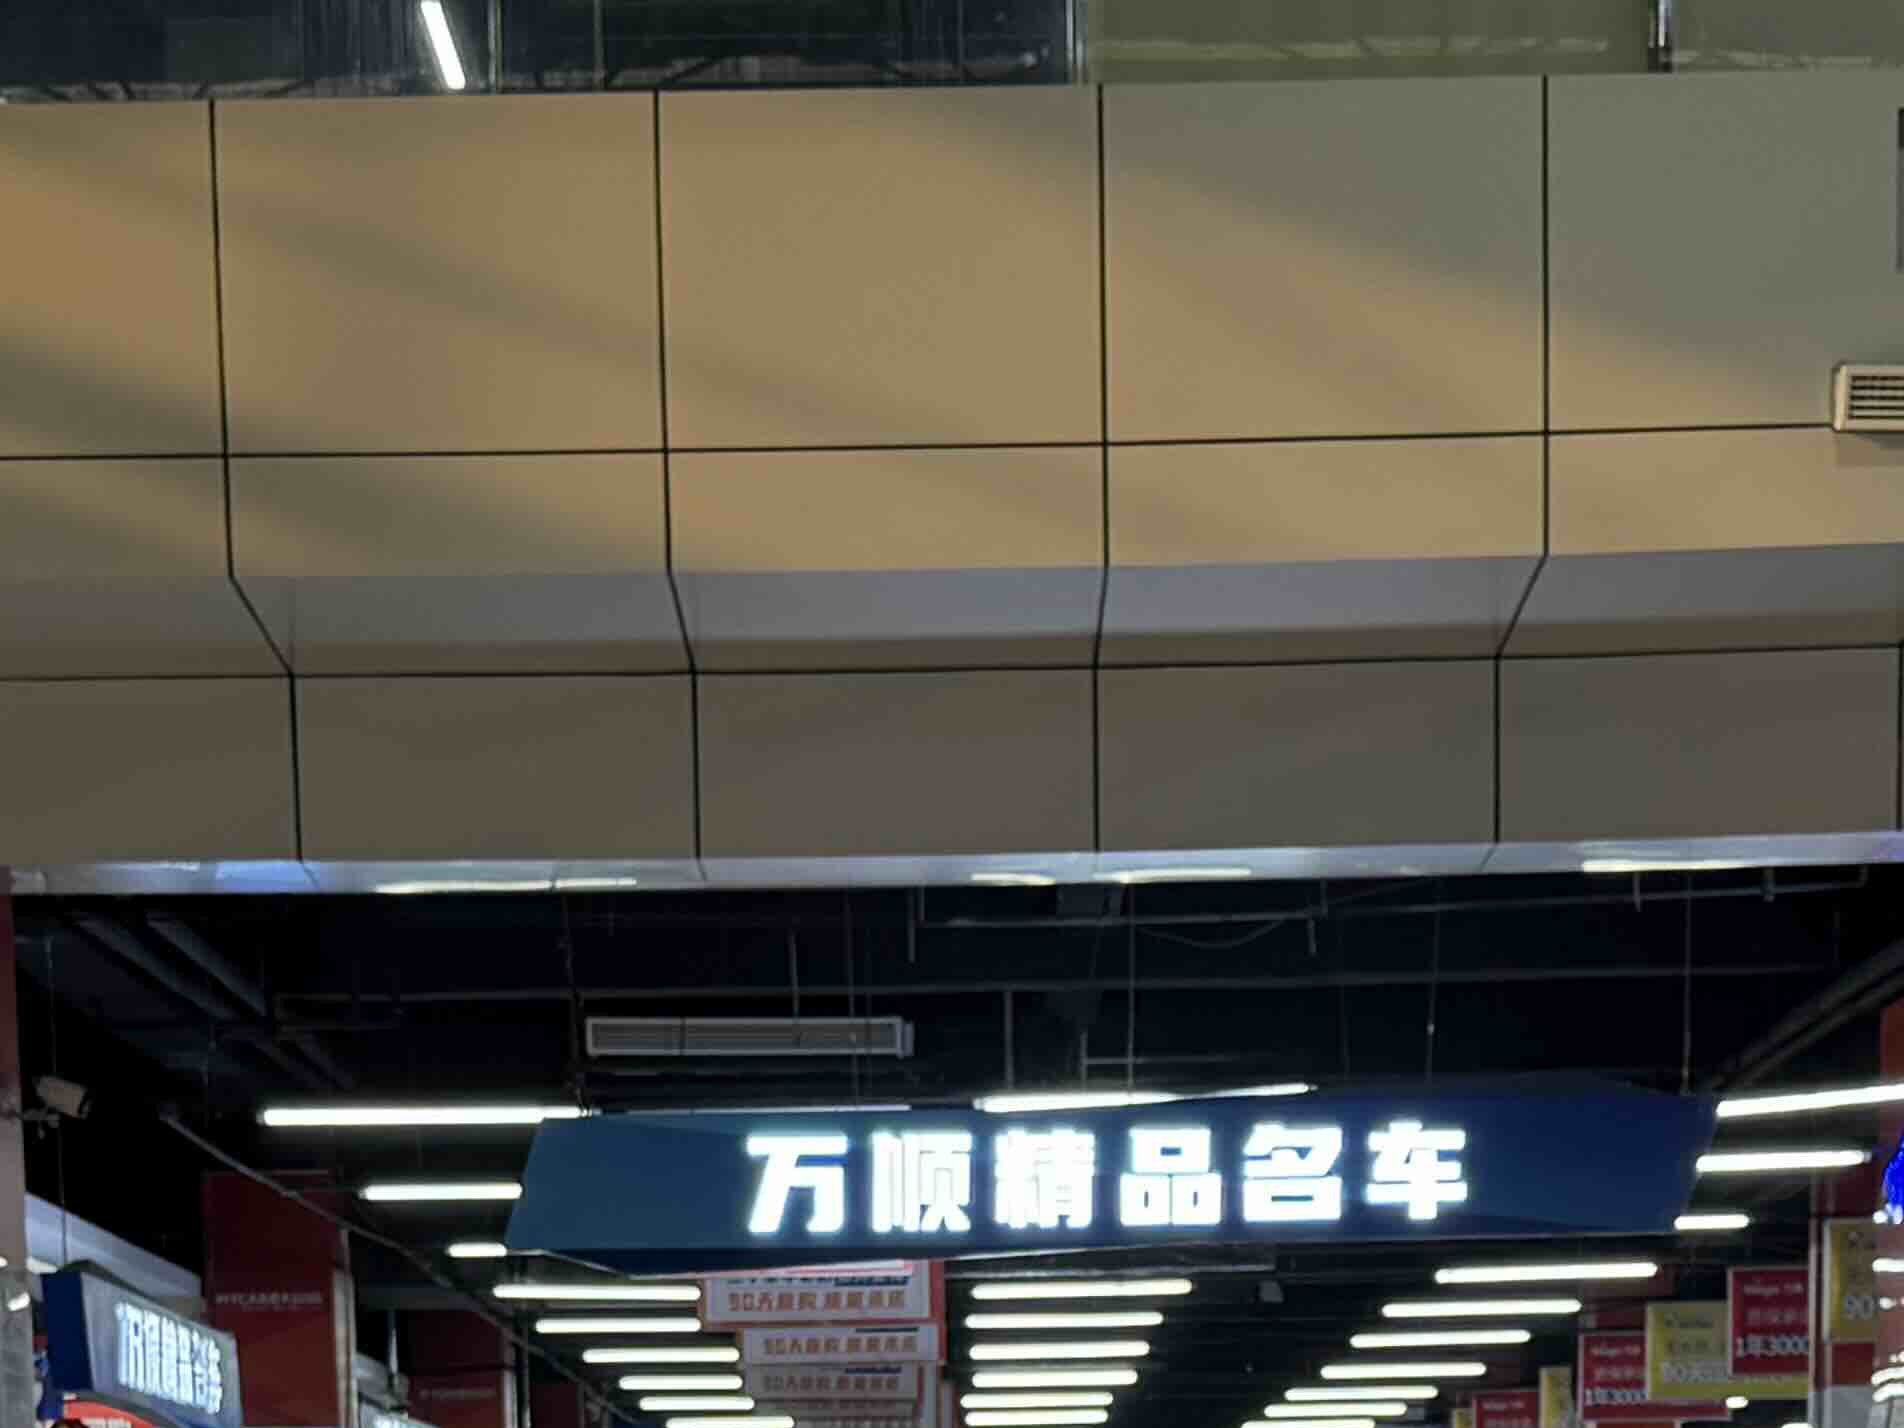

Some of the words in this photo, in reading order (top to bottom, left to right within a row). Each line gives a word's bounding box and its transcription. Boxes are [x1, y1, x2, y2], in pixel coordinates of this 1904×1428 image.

[746, 1122, 1468, 1236] 万顺精品名车
